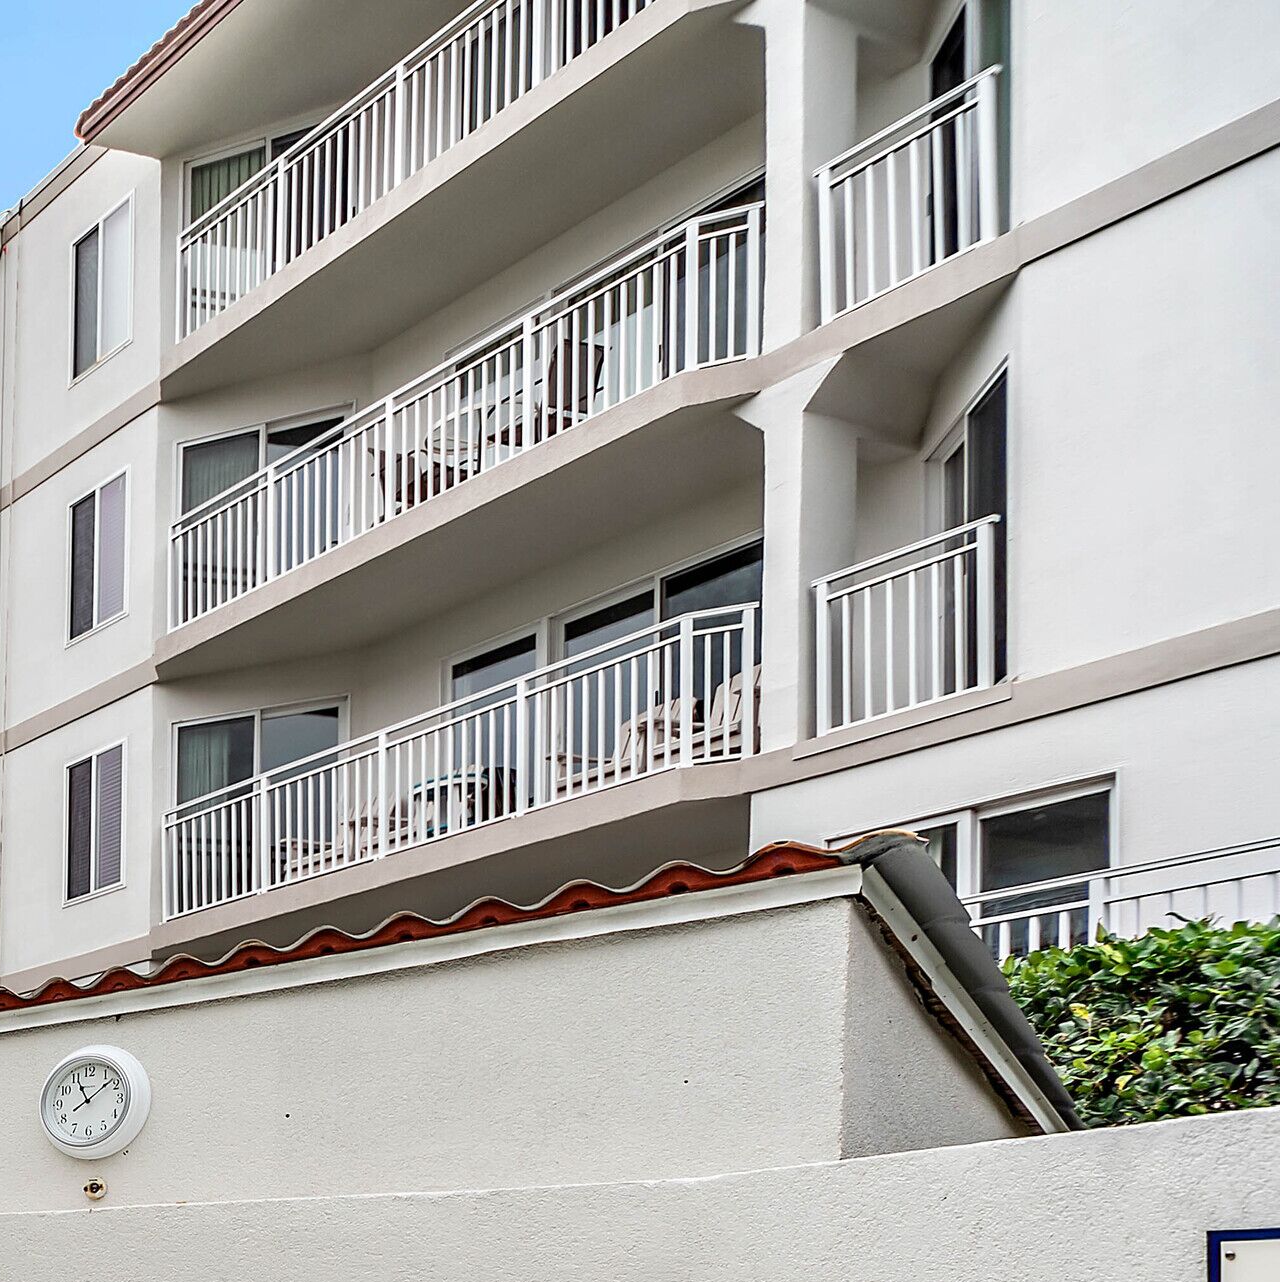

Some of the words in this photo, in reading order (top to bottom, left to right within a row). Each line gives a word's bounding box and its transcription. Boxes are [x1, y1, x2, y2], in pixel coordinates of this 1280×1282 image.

[84, 1066, 96, 1077] 12
[104, 1069, 108, 1079] 1
[72, 1073, 80, 1084] 11
[113, 1078, 120, 1090] 2
[61, 1085, 71, 1096] 10
[116, 1093, 124, 1104] 3
[56, 1100, 63, 1111] 9
[60, 1113, 67, 1124] 8
[111, 1109, 118, 1119] 4
[71, 1123, 78, 1134] 7
[84, 1125, 92, 1136] 6
[100, 1120, 107, 1131] 5
